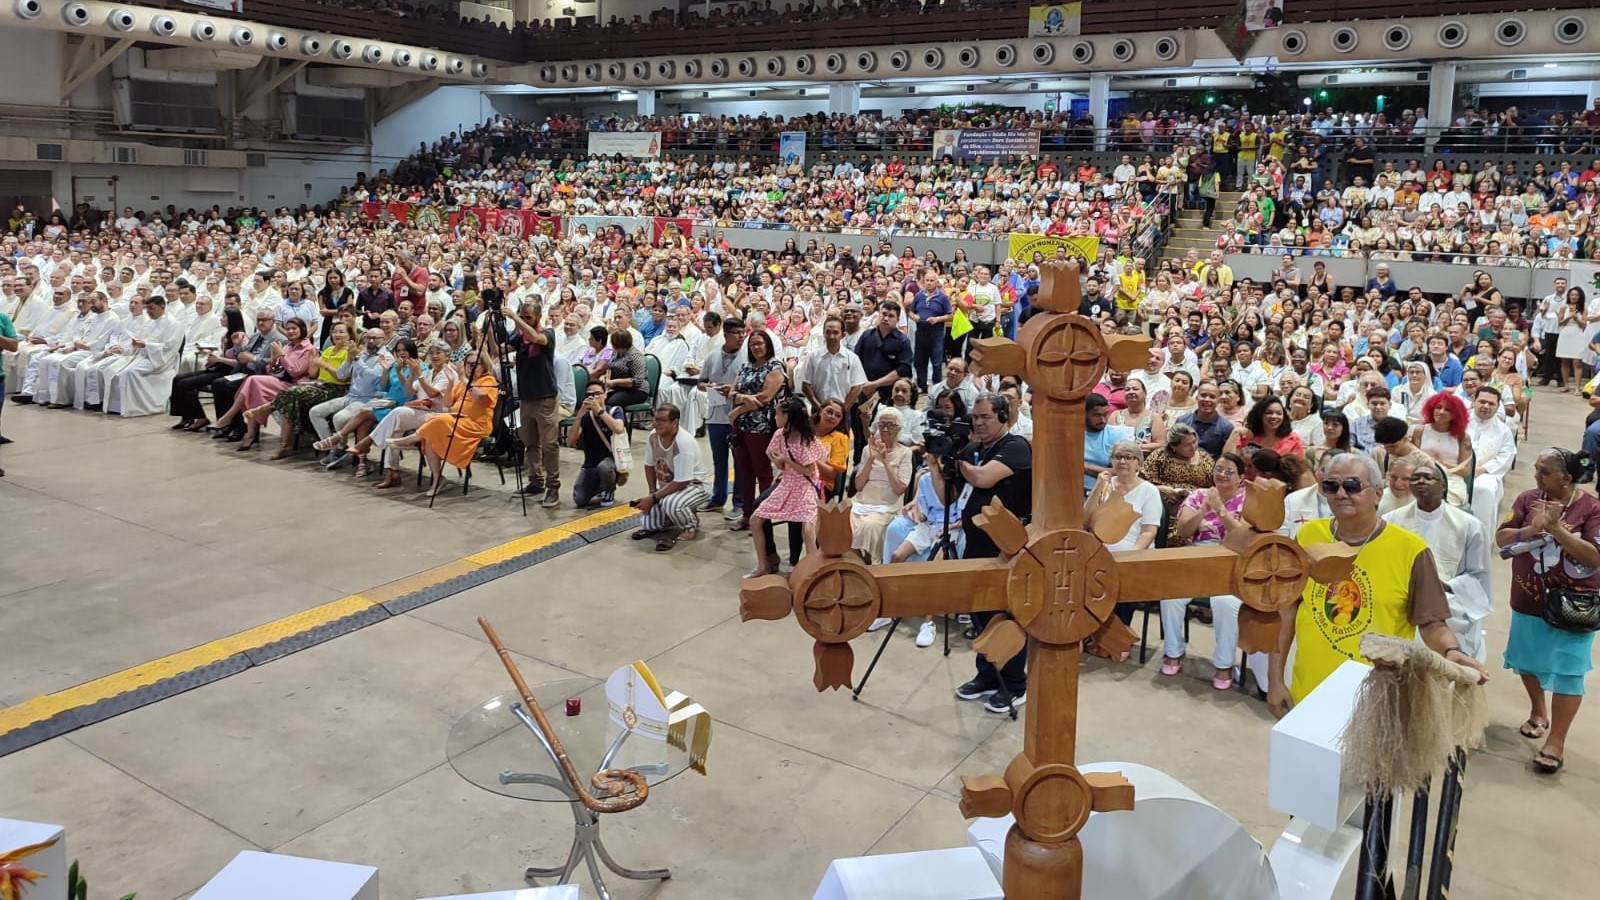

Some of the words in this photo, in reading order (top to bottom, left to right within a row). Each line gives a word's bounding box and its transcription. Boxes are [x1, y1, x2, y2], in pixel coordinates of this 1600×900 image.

[1023, 243, 1037, 254] DOS
[1036, 239, 1064, 247] HOMENS
[1350, 570, 1368, 608] Homens
[1331, 619, 1362, 635] Rainha
